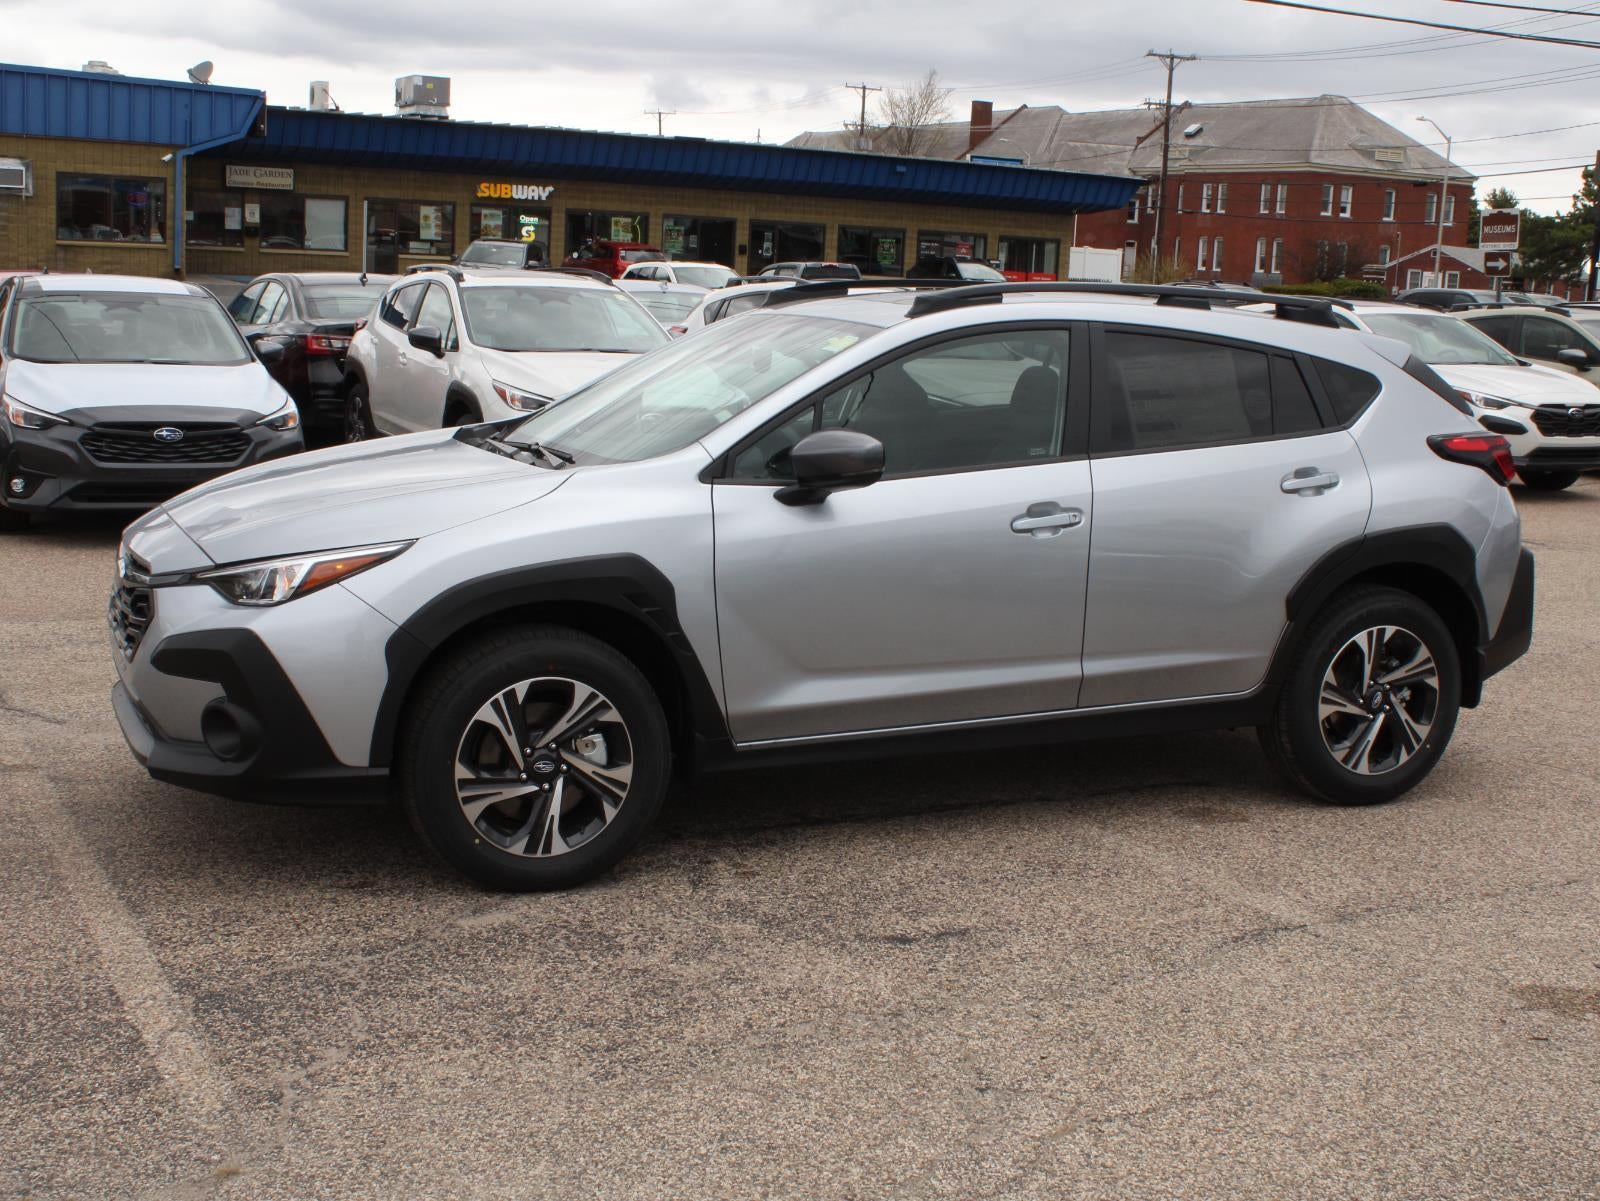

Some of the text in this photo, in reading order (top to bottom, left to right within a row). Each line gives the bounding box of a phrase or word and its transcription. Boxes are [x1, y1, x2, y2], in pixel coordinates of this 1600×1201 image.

[254, 168, 293, 179] GARDEN
[477, 182, 554, 200] SUBWAY
[520, 215, 539, 224] Open
[1484, 225, 1516, 234] MUSEUMS
